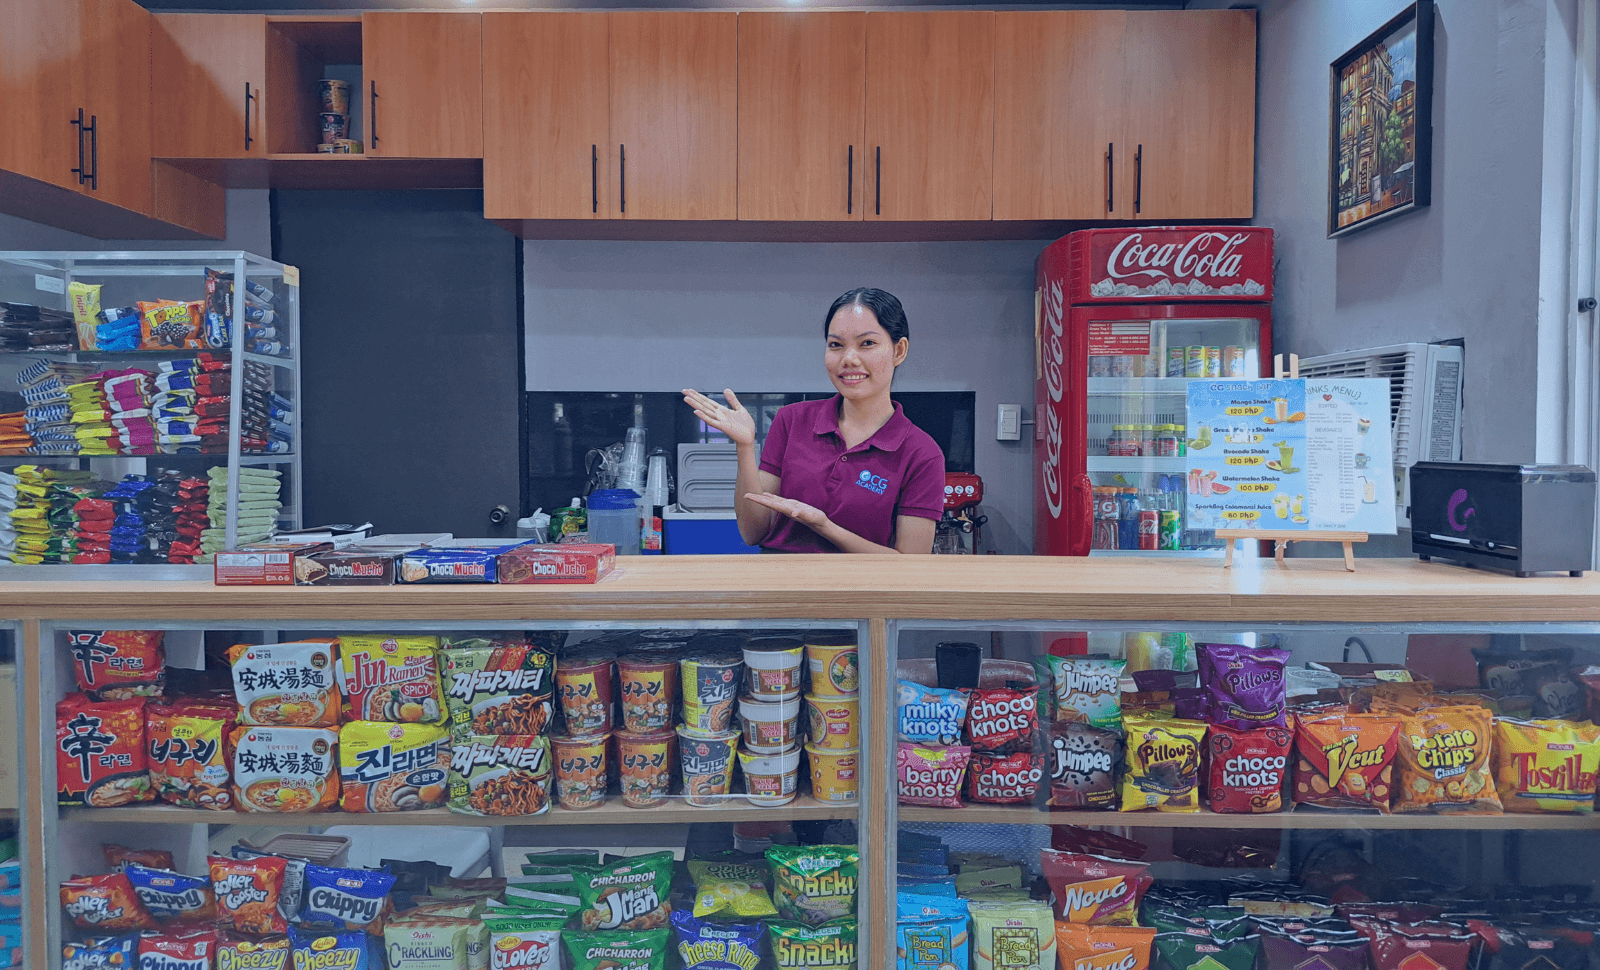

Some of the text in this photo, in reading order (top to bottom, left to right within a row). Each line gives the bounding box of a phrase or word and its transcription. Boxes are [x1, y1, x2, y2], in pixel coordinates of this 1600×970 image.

[1107, 232, 1251, 279] Coca-Cola
[145, 304, 188, 328] TOPPS
[1042, 272, 1064, 519] Coca-Cola
[855, 480, 885, 495] ACADEMY
[871, 475, 889, 490] CG
[68, 630, 118, 685] 辛
[109, 656, 144, 670] 라면
[238, 666, 326, 692] 安城湯麵
[349, 651, 424, 695] Jin Ramen
[1059, 662, 1118, 700] jumpee
[1227, 670, 1280, 694] Pillows
[404, 685, 429, 695] SPICY
[449, 669, 545, 704] 짜파게티
[622, 680, 661, 699] 너구리
[700, 683, 737, 706] 진라
[905, 702, 960, 721] milky
[970, 696, 1035, 720] choco
[902, 717, 958, 735] knots
[970, 714, 1029, 738] knots
[61, 712, 117, 783] 辛
[1411, 729, 1477, 751] Potato
[99, 753, 133, 769] 라면
[150, 737, 218, 766] 너구리
[238, 748, 325, 776] 安城湯麵
[355, 742, 438, 783] 진라면
[450, 742, 544, 777] 짜파게티
[623, 751, 665, 773] 너구리
[1051, 739, 1111, 779] jumpee
[1145, 744, 1195, 765] Pillows
[1417, 747, 1475, 768] Chips
[560, 752, 603, 775] 너구리
[682, 755, 726, 776] 진라면
[1225, 754, 1286, 772] choco
[1326, 741, 1386, 788] Vcut
[1434, 765, 1466, 780] Classic
[412, 772, 440, 783] 순한맛
[906, 766, 961, 785] berry
[980, 768, 1042, 787] choco
[1222, 769, 1279, 787] knots
[898, 781, 956, 797] knots
[977, 782, 1036, 798] knots
[589, 870, 656, 889] CHICHARRON
[140, 889, 202, 909] Chippy
[225, 885, 269, 910] Coaster
[621, 884, 655, 902] Mang
[1063, 882, 1128, 917] Nova
[312, 889, 378, 921] Chippy
[598, 889, 659, 930] Juan
[586, 947, 653, 960] CHICHARRON
[678, 940, 725, 967] Cheese
[912, 936, 944, 949] Bread
[1000, 937, 1032, 951] Bread
[217, 947, 288, 970] Cheezy
[293, 947, 360, 970] Cheezy
[494, 945, 550, 969] CLOVER
[918, 948, 940, 962] Pan
[1005, 951, 1027, 963] Pan
